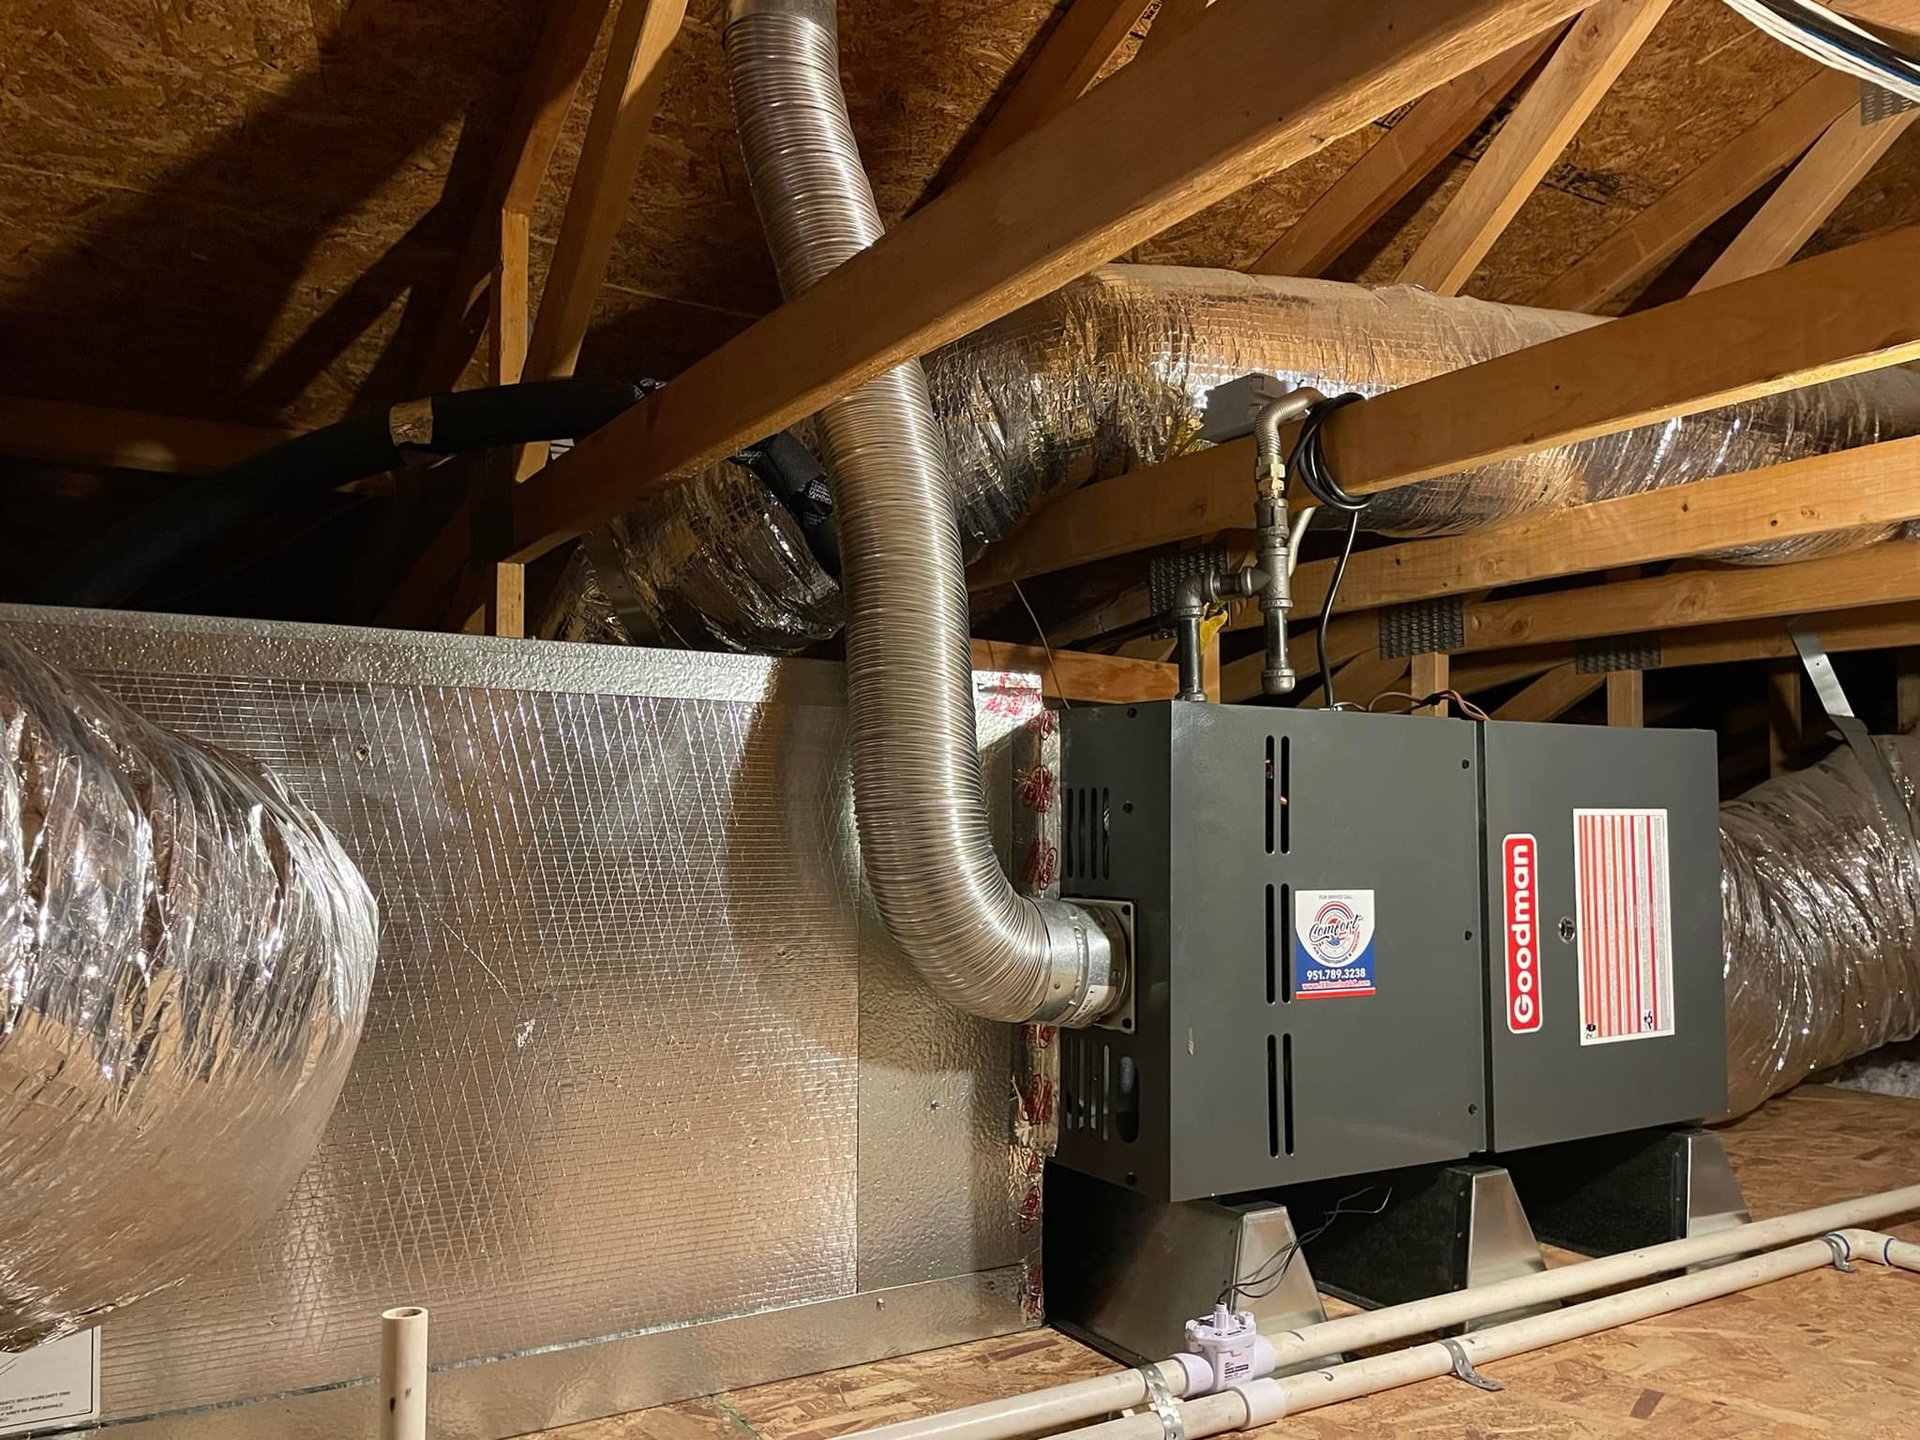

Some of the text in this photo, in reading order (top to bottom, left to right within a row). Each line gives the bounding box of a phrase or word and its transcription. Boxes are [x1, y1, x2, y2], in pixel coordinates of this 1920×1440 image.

[1309, 914, 1363, 943] Comfort
[1512, 845, 1534, 1024] Goodman
[1306, 968, 1366, 980] 951.789.3238
